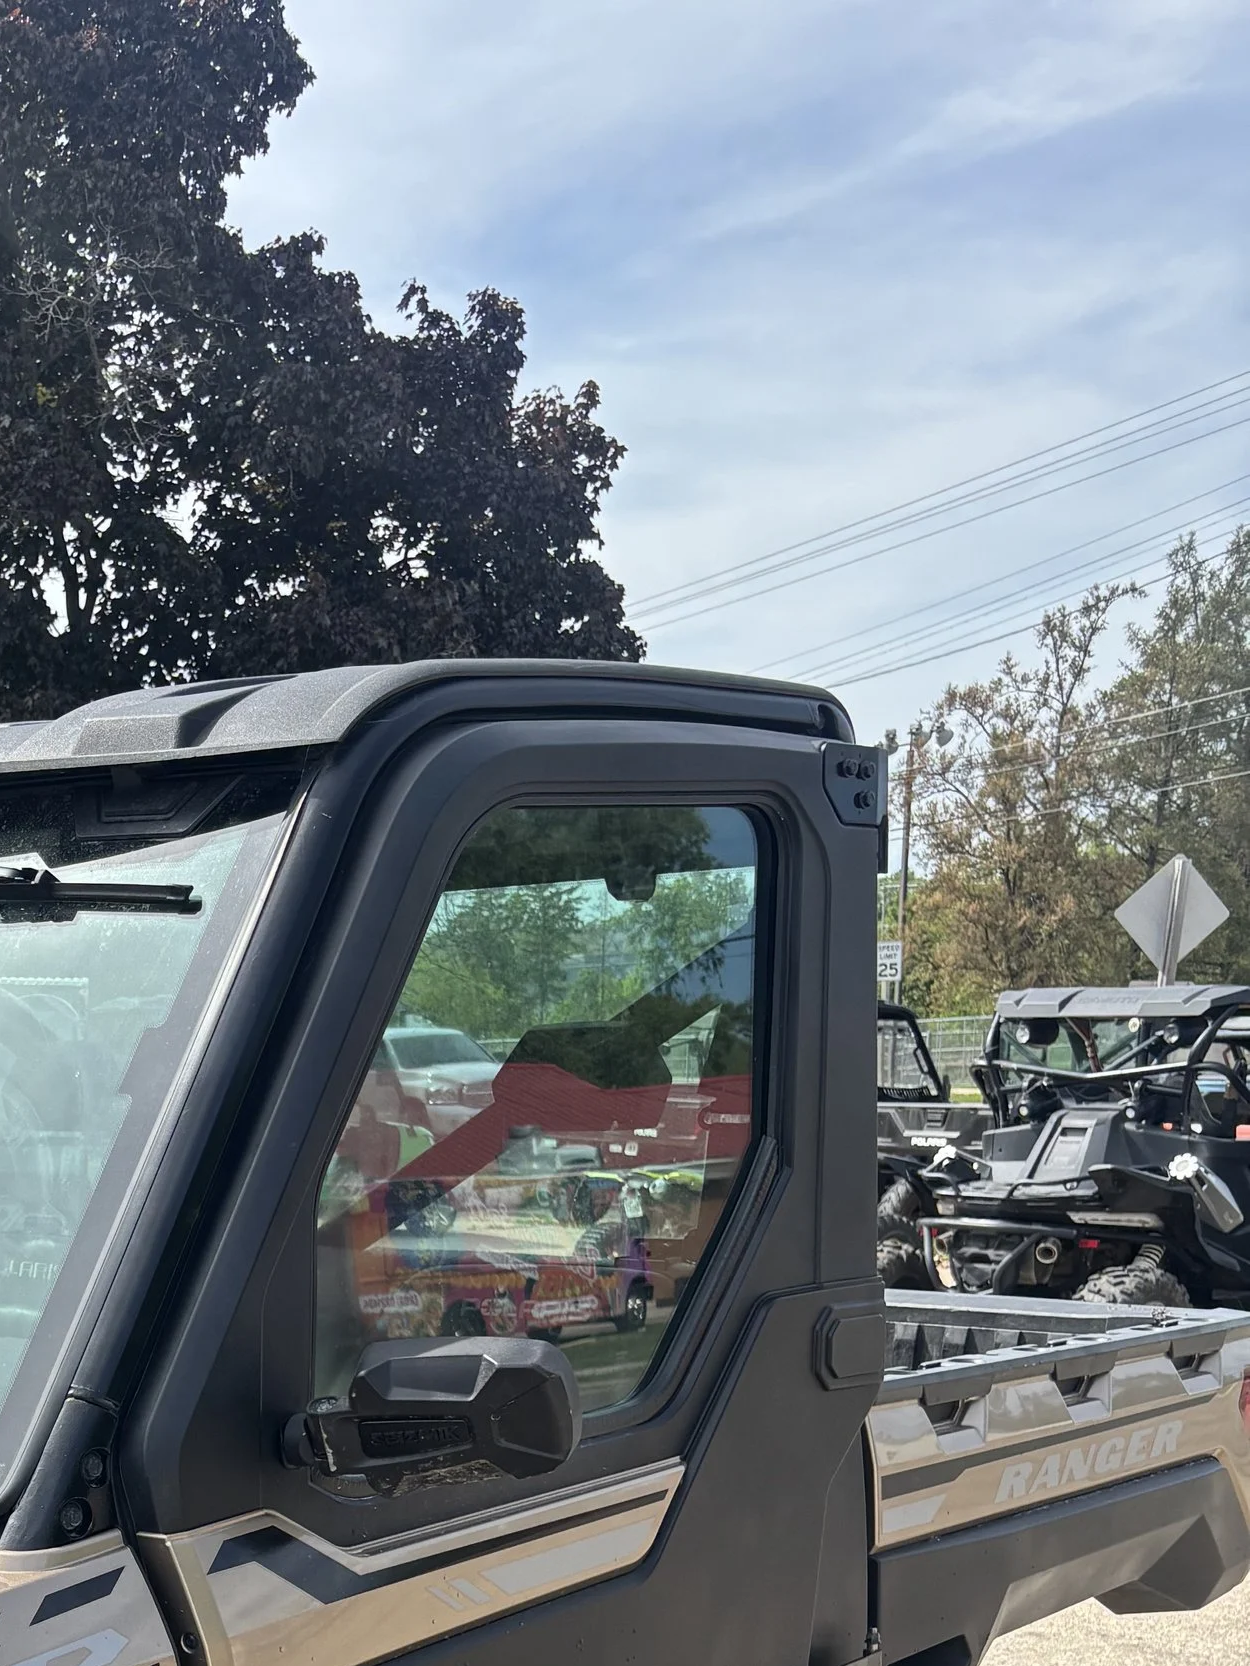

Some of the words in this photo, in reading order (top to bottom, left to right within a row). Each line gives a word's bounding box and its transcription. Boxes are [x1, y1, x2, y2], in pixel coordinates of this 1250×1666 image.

[879, 952, 898, 960] LIMIT
[878, 963, 898, 977] 25
[911, 1136, 948, 1147] POLARIS
[994, 1420, 1184, 1504] RANGER
